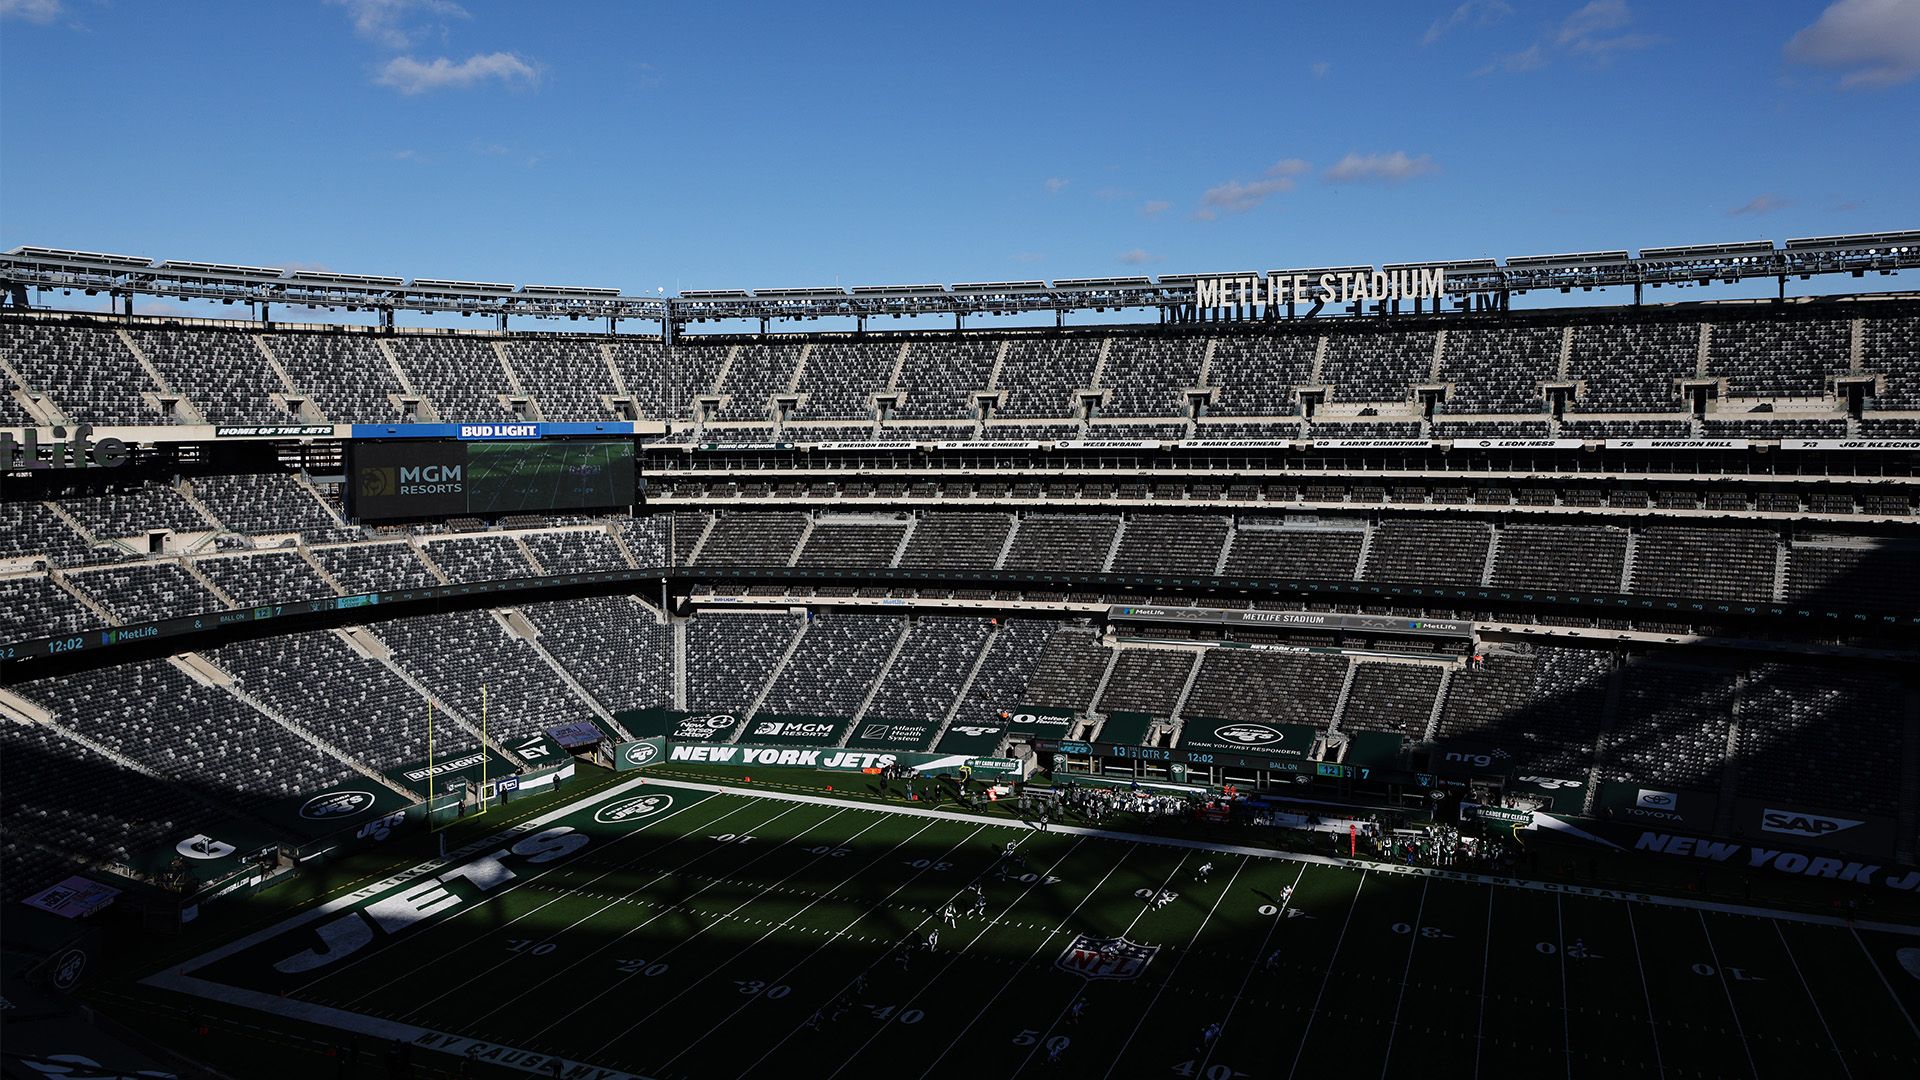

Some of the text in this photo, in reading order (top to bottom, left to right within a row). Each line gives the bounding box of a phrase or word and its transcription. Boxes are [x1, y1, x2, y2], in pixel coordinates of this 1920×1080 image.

[1196, 274, 1309, 308] METLIFE
[1319, 267, 1445, 303] STADIUM
[218, 426, 333, 435] HOME OF THE JETS
[461, 425, 537, 437] BUD LIGHT
[400, 464, 462, 484] MGM
[400, 483, 463, 495] RESORTS
[220, 613, 245, 623] BALL ON
[275, 606, 284, 616] 7
[1135, 608, 1165, 617] MetLife
[1242, 613, 1325, 624] METLIFE STADIUM
[193, 619, 203, 629] &
[1423, 622, 1457, 631] MetLife
[119, 626, 159, 641] MetLife
[7, 647, 15, 657] 2
[48, 637, 84, 654] 12:02
[673, 730, 713, 739] Lottery
[785, 722, 834, 733] MGM
[887, 735, 920, 743] System
[518, 745, 550, 760] EY
[670, 745, 897, 770] NEW YORK JETS
[1112, 746, 1125, 757] 13
[1141, 750, 1170, 760] QTR 2
[1187, 753, 1214, 764] 12:02
[1251, 747, 1301, 756] RESPONDERS
[412, 754, 487, 780] BUD LIGHT
[1269, 762, 1287, 770] BALL
[1445, 752, 1492, 767] nrg
[1323, 766, 1336, 775] 12
[1361, 768, 1370, 779] 7
[1518, 775, 1583, 789] JETS
[1624, 807, 1686, 823] TOYOTA
[356, 811, 406, 841] JETS
[1764, 813, 1839, 833] SAP
[717, 833, 758, 845] 10
[353, 887, 373, 898] IT
[379, 857, 445, 888] TAKES
[512, 822, 538, 832] US
[1634, 831, 1920, 892] NEW YORK J
[1014, 871, 1062, 886] 40
[1346, 860, 1652, 901] MY CAUSE MY CLEATS
[272, 825, 592, 976] JETS
[1258, 904, 1305, 919] 40
[509, 938, 559, 956] 10
[618, 959, 671, 977] 20
[1065, 950, 1135, 975] NFL
[1690, 963, 1742, 982] 10
[737, 979, 792, 1000] 30
[870, 1004, 926, 1024] 40
[1011, 1028, 1073, 1056] 50
[415, 1031, 462, 1048] MY
[464, 1042, 555, 1073] CAUSE
[1172, 1058, 1234, 1080] 40
